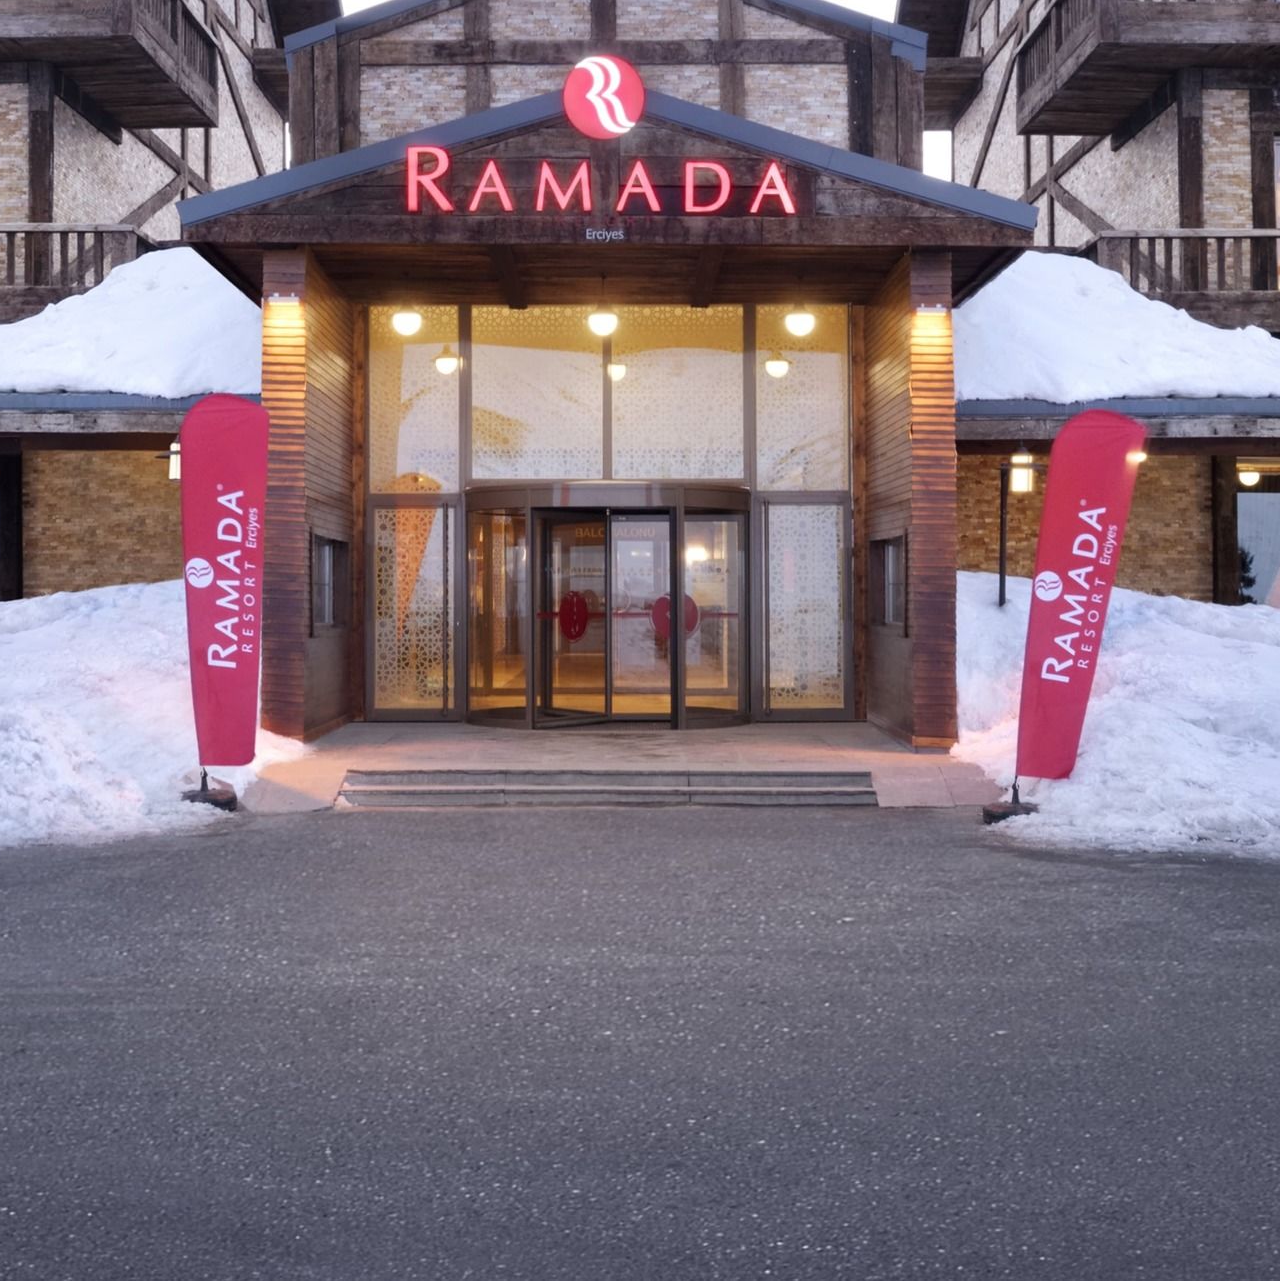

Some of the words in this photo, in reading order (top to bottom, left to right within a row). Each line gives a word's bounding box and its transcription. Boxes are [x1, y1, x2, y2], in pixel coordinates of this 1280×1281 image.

[406, 146, 796, 214] RAMADA
[586, 228, 624, 243] Erciyes
[246, 507, 261, 549] Erciyes
[242, 561, 257, 653] RESORT
[1077, 577, 1107, 669] RESORT
[1099, 524, 1118, 566] Erciyes
